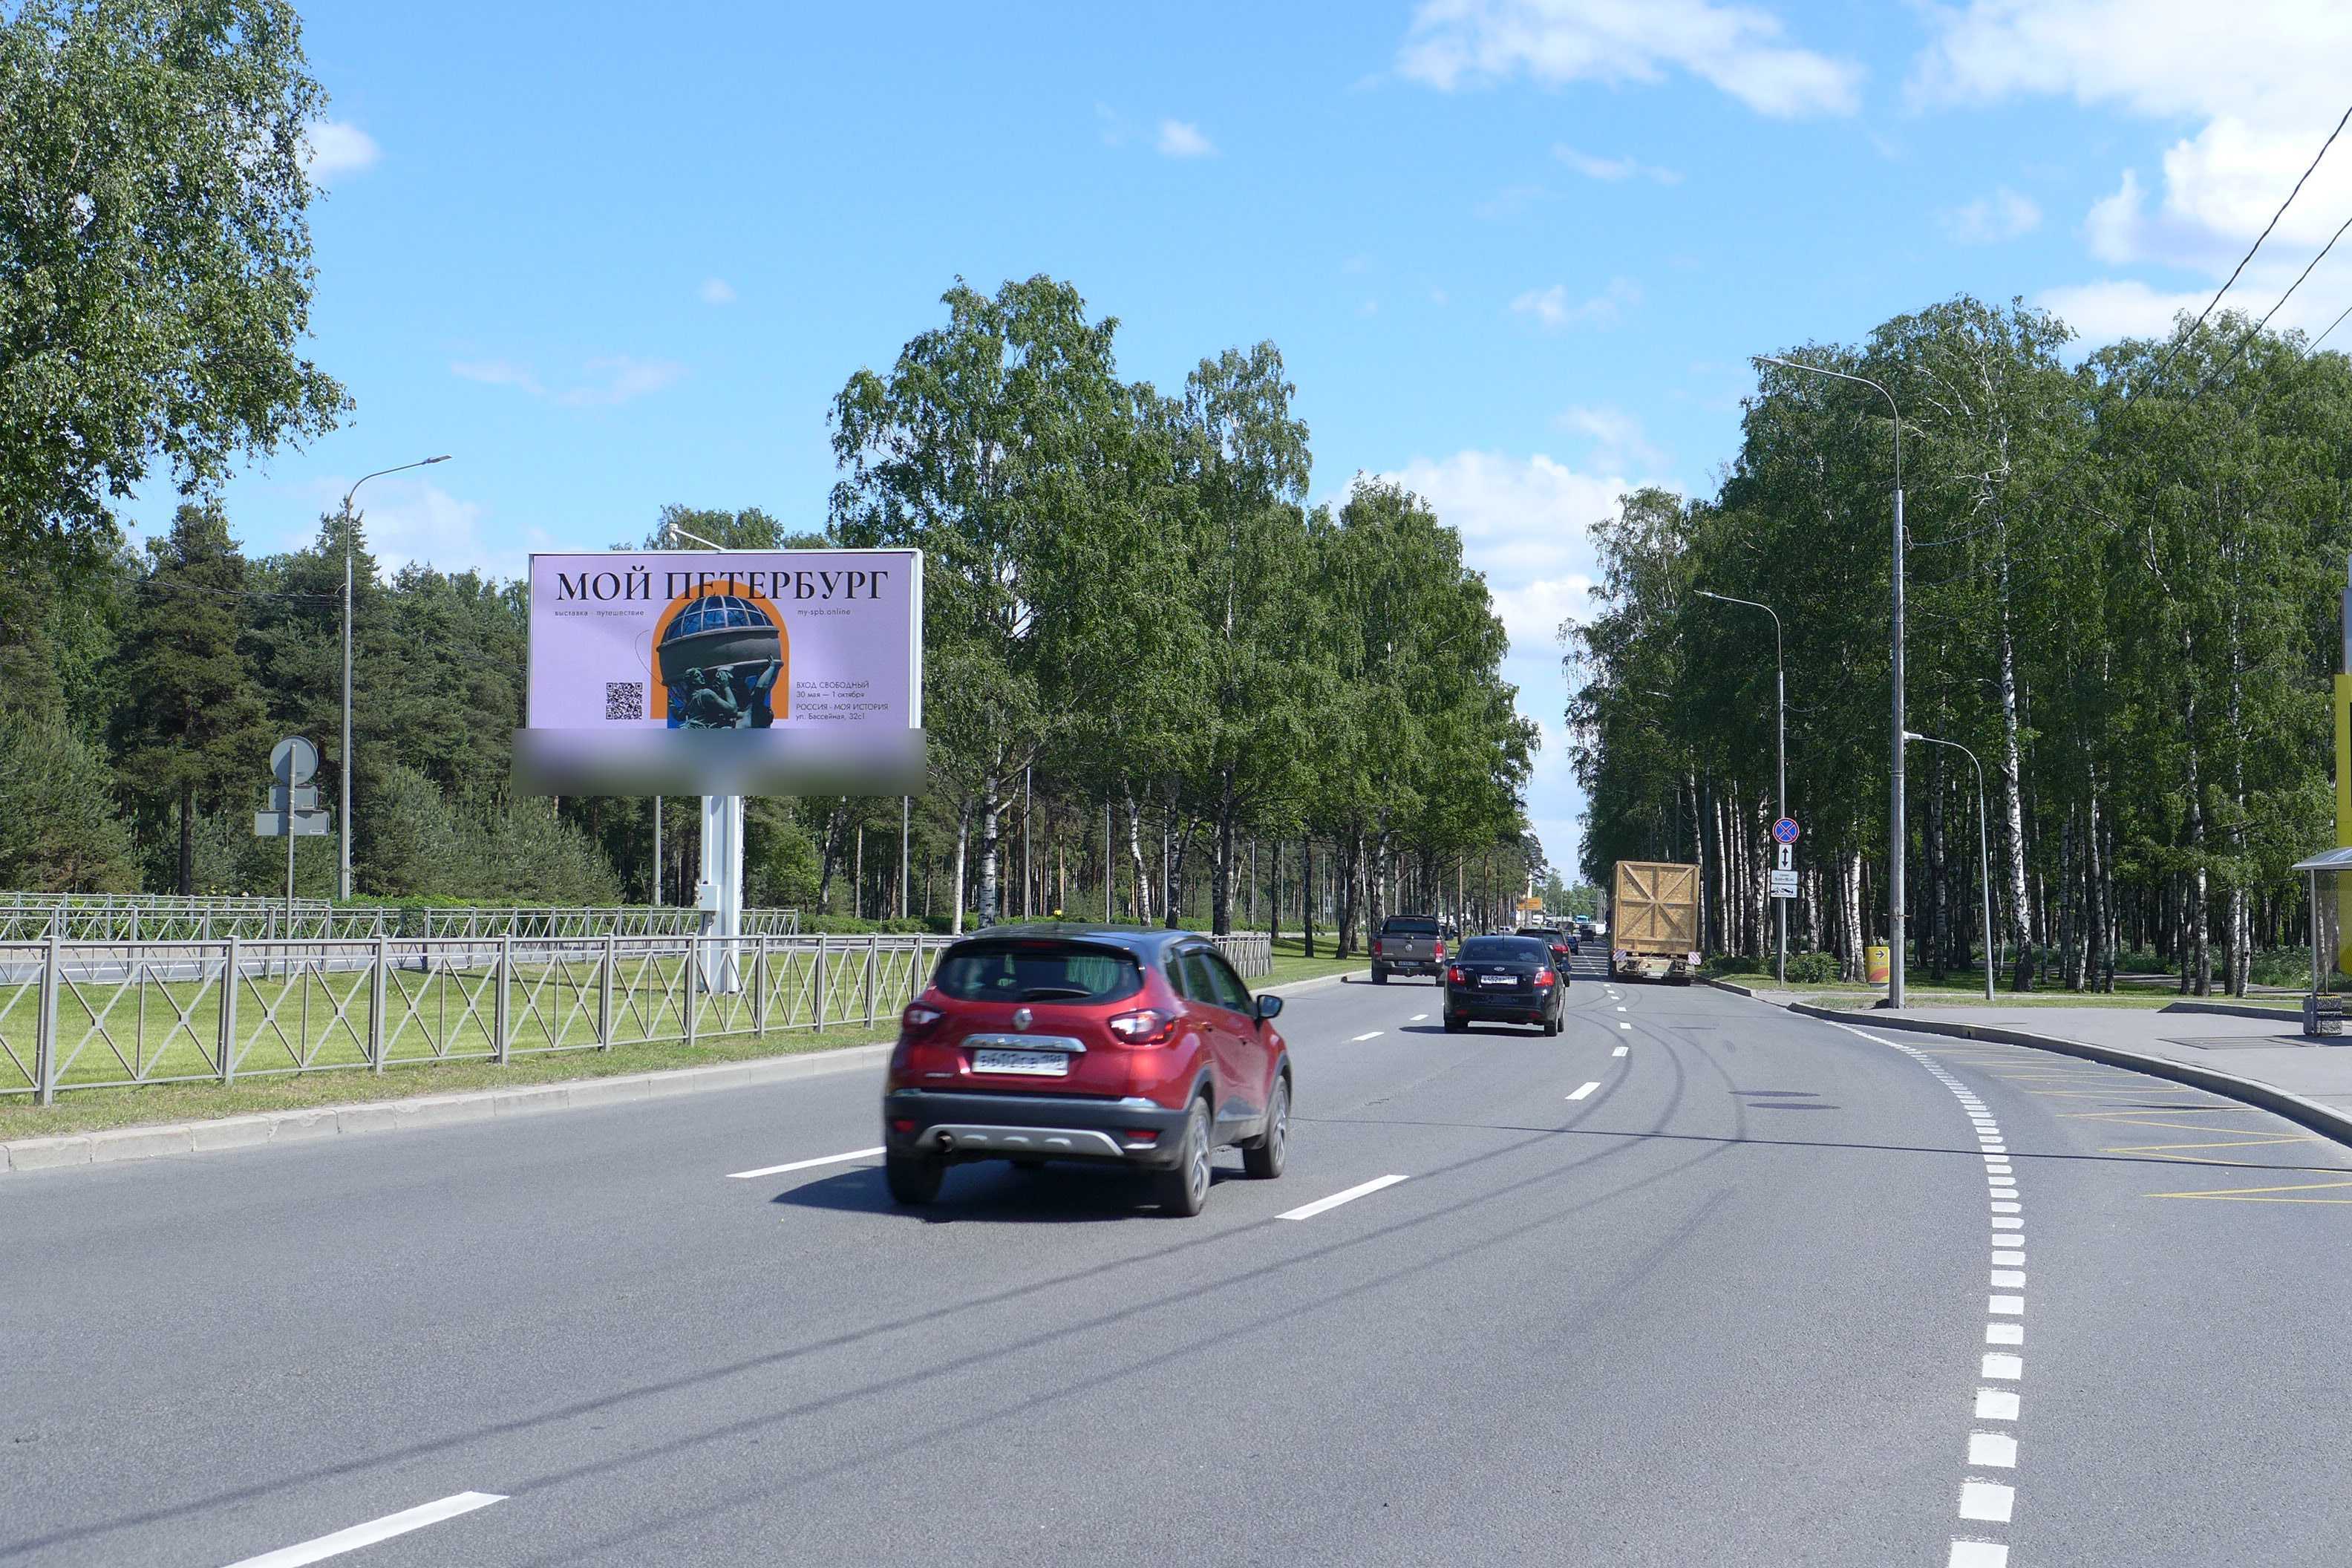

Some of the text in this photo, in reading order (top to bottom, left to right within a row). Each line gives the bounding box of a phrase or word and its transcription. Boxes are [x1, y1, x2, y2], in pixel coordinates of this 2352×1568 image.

[556, 565, 889, 601] МОЙ ПЕТЕРБУРГ
[797, 607, 852, 616] my-spb.online
[819, 680, 870, 689] СВОБОДНЫЙ
[837, 690, 865, 699] октября
